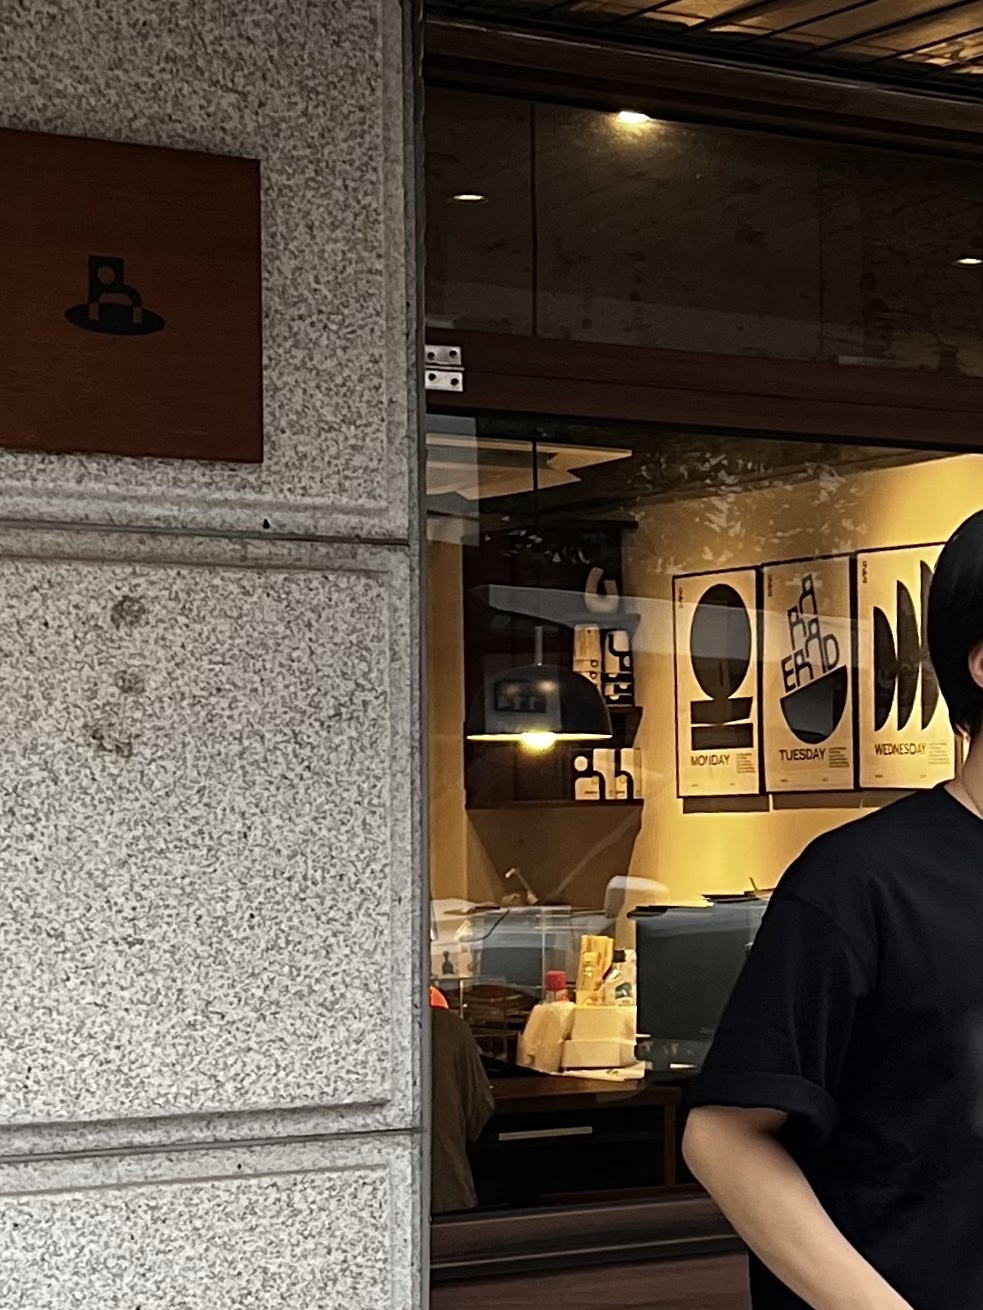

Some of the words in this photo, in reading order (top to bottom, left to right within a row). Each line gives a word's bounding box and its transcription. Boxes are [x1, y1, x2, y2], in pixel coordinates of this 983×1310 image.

[779, 748, 826, 761] TUESDAY
[875, 743, 926, 755] WEDNESDAY
[691, 755, 730, 766] MONDAY
